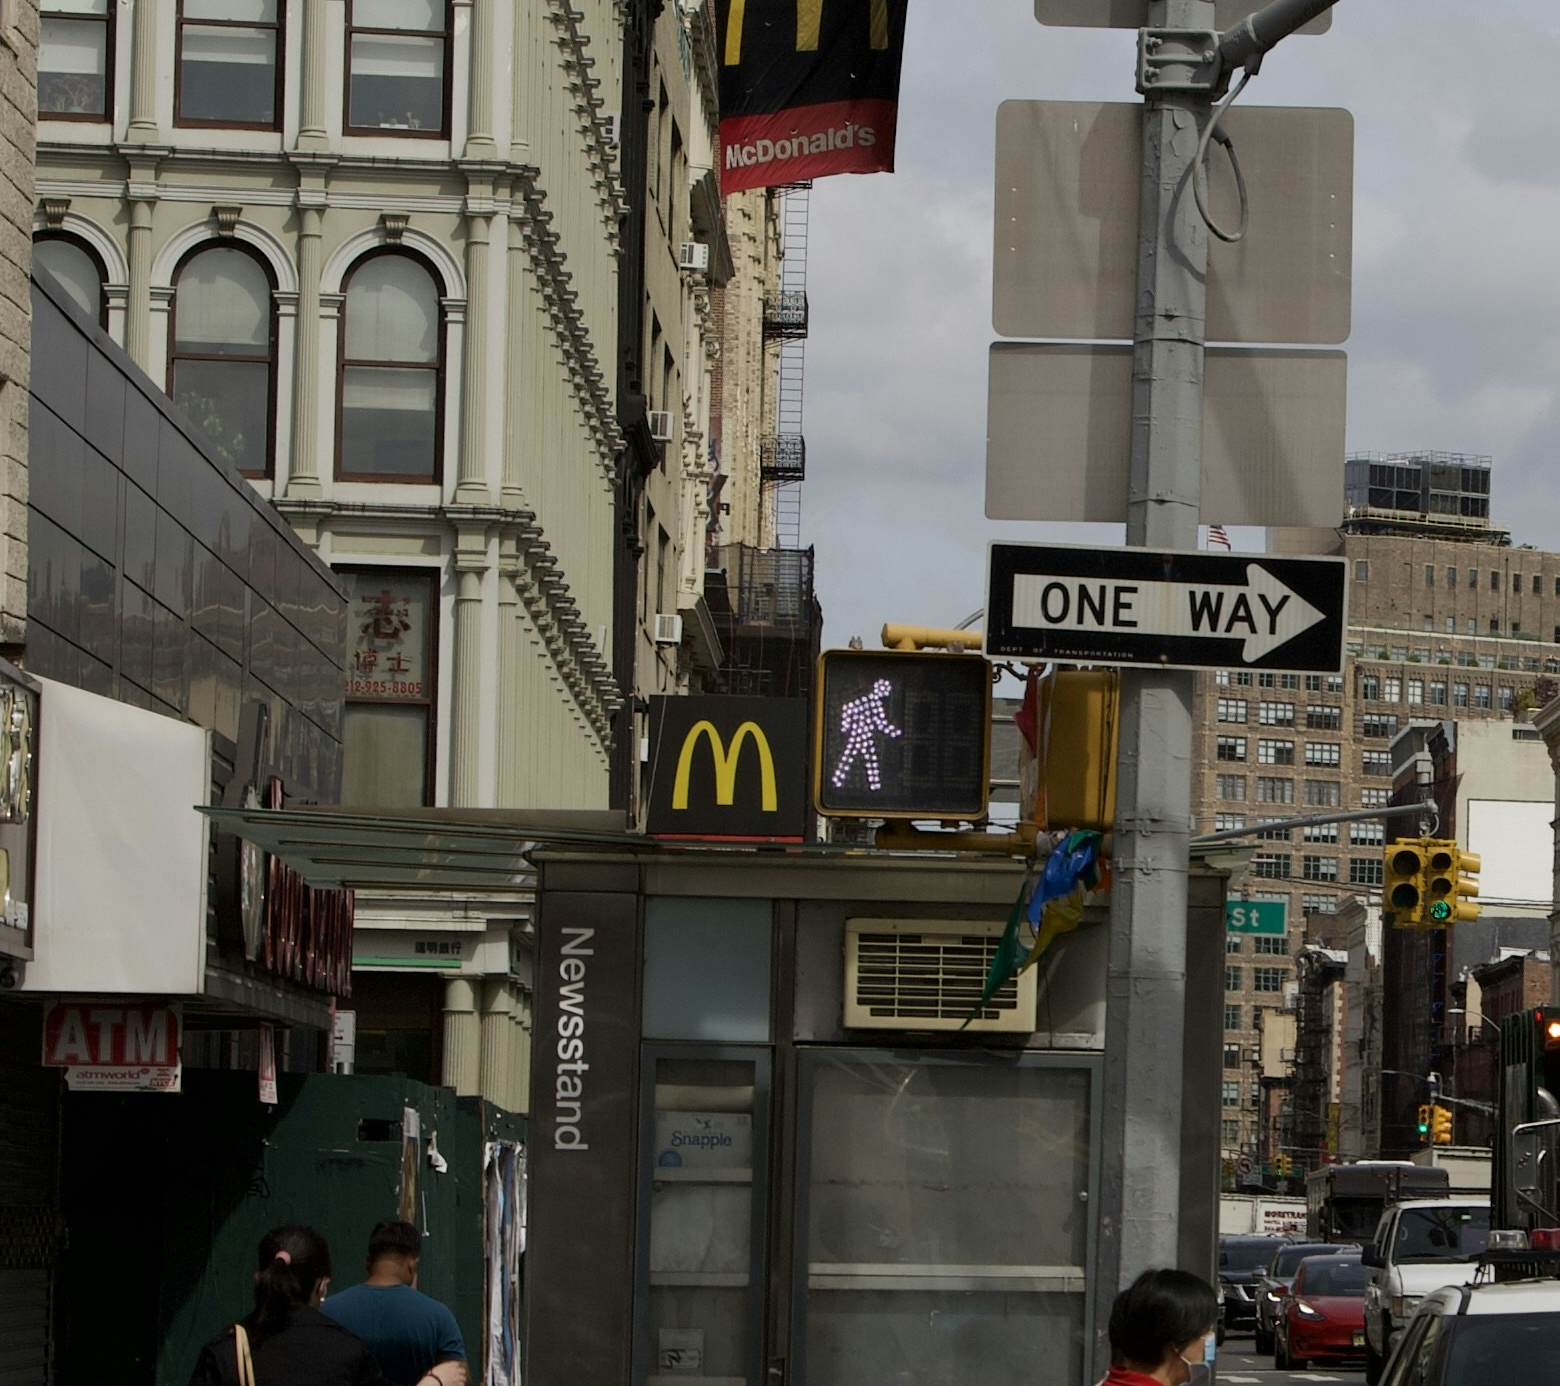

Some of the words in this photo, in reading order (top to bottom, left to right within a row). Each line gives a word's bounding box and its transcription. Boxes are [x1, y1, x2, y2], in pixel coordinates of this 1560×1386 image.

[725, 124, 877, 170] McDonald's
[1040, 582, 1139, 628] ONE
[1188, 590, 1292, 635] WAY
[999, 645, 1024, 653] DEPT
[1032, 647, 1044, 655] OF
[1054, 648, 1135, 660] TRANSPORTATION
[1231, 907, 1260, 928] St
[53, 1009, 169, 1063] ATM
[555, 926, 595, 1151] Newsstand
[76, 1069, 141, 1082] atmworld
[671, 1131, 733, 1150] Snapple
